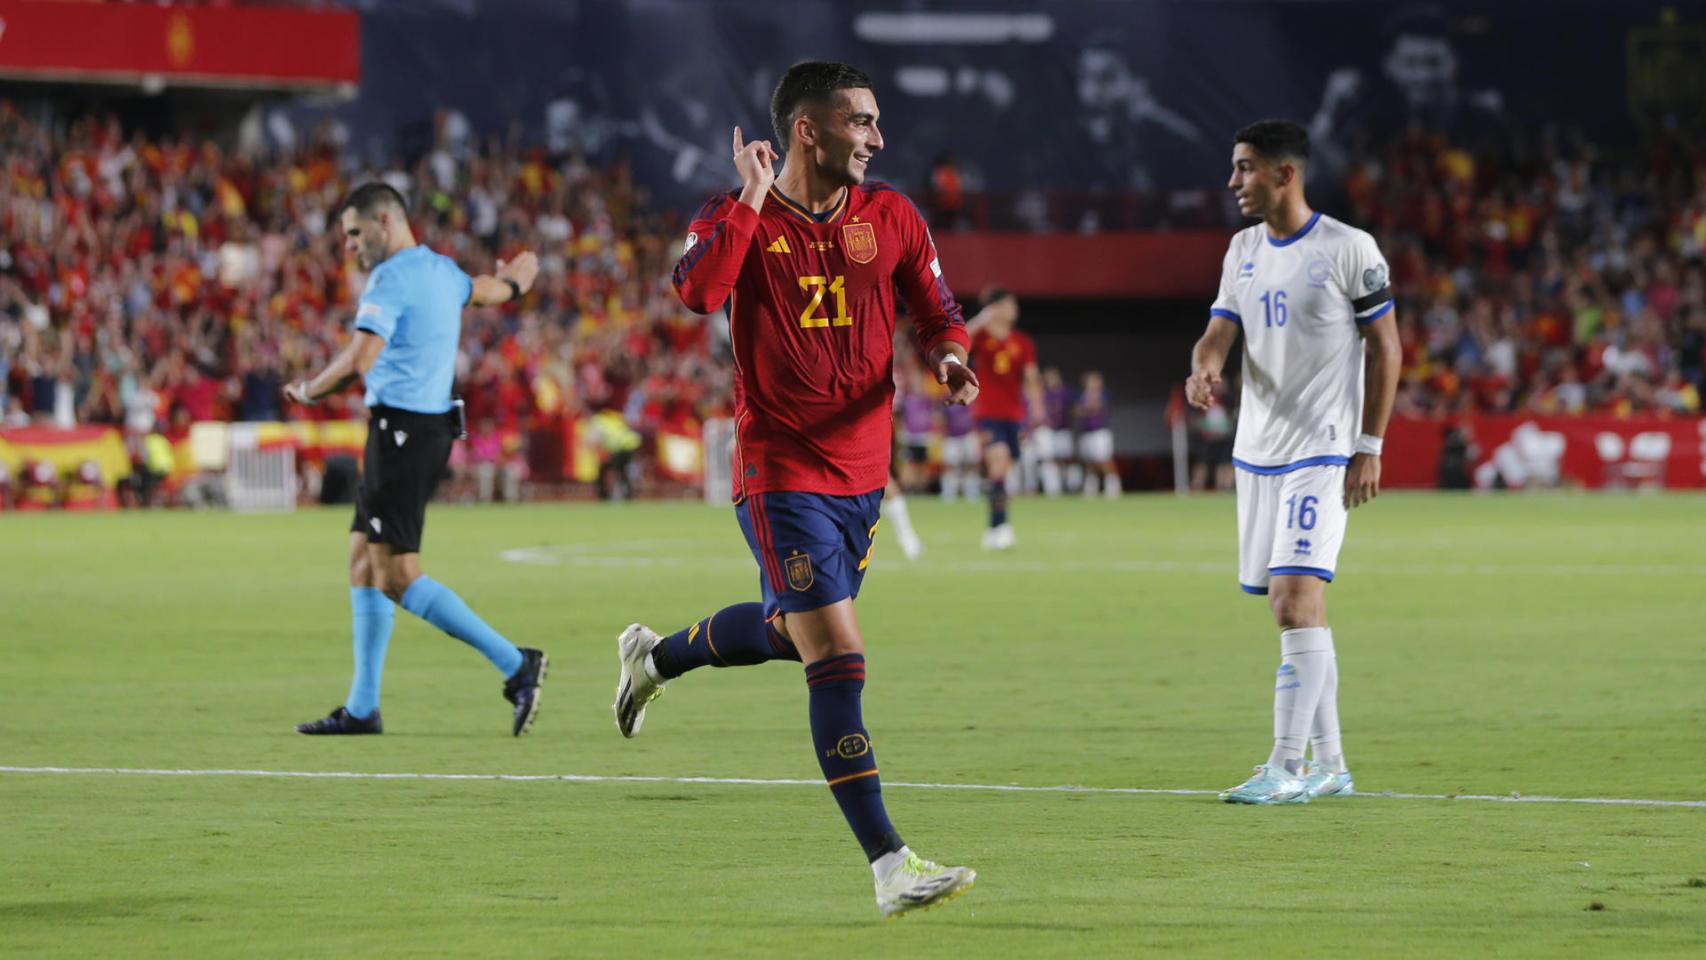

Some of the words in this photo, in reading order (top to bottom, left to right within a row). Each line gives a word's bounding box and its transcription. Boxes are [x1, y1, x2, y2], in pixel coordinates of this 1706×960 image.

[799, 275, 853, 328] 21
[1260, 290, 1287, 328] 16
[1286, 494, 1319, 530] 16
